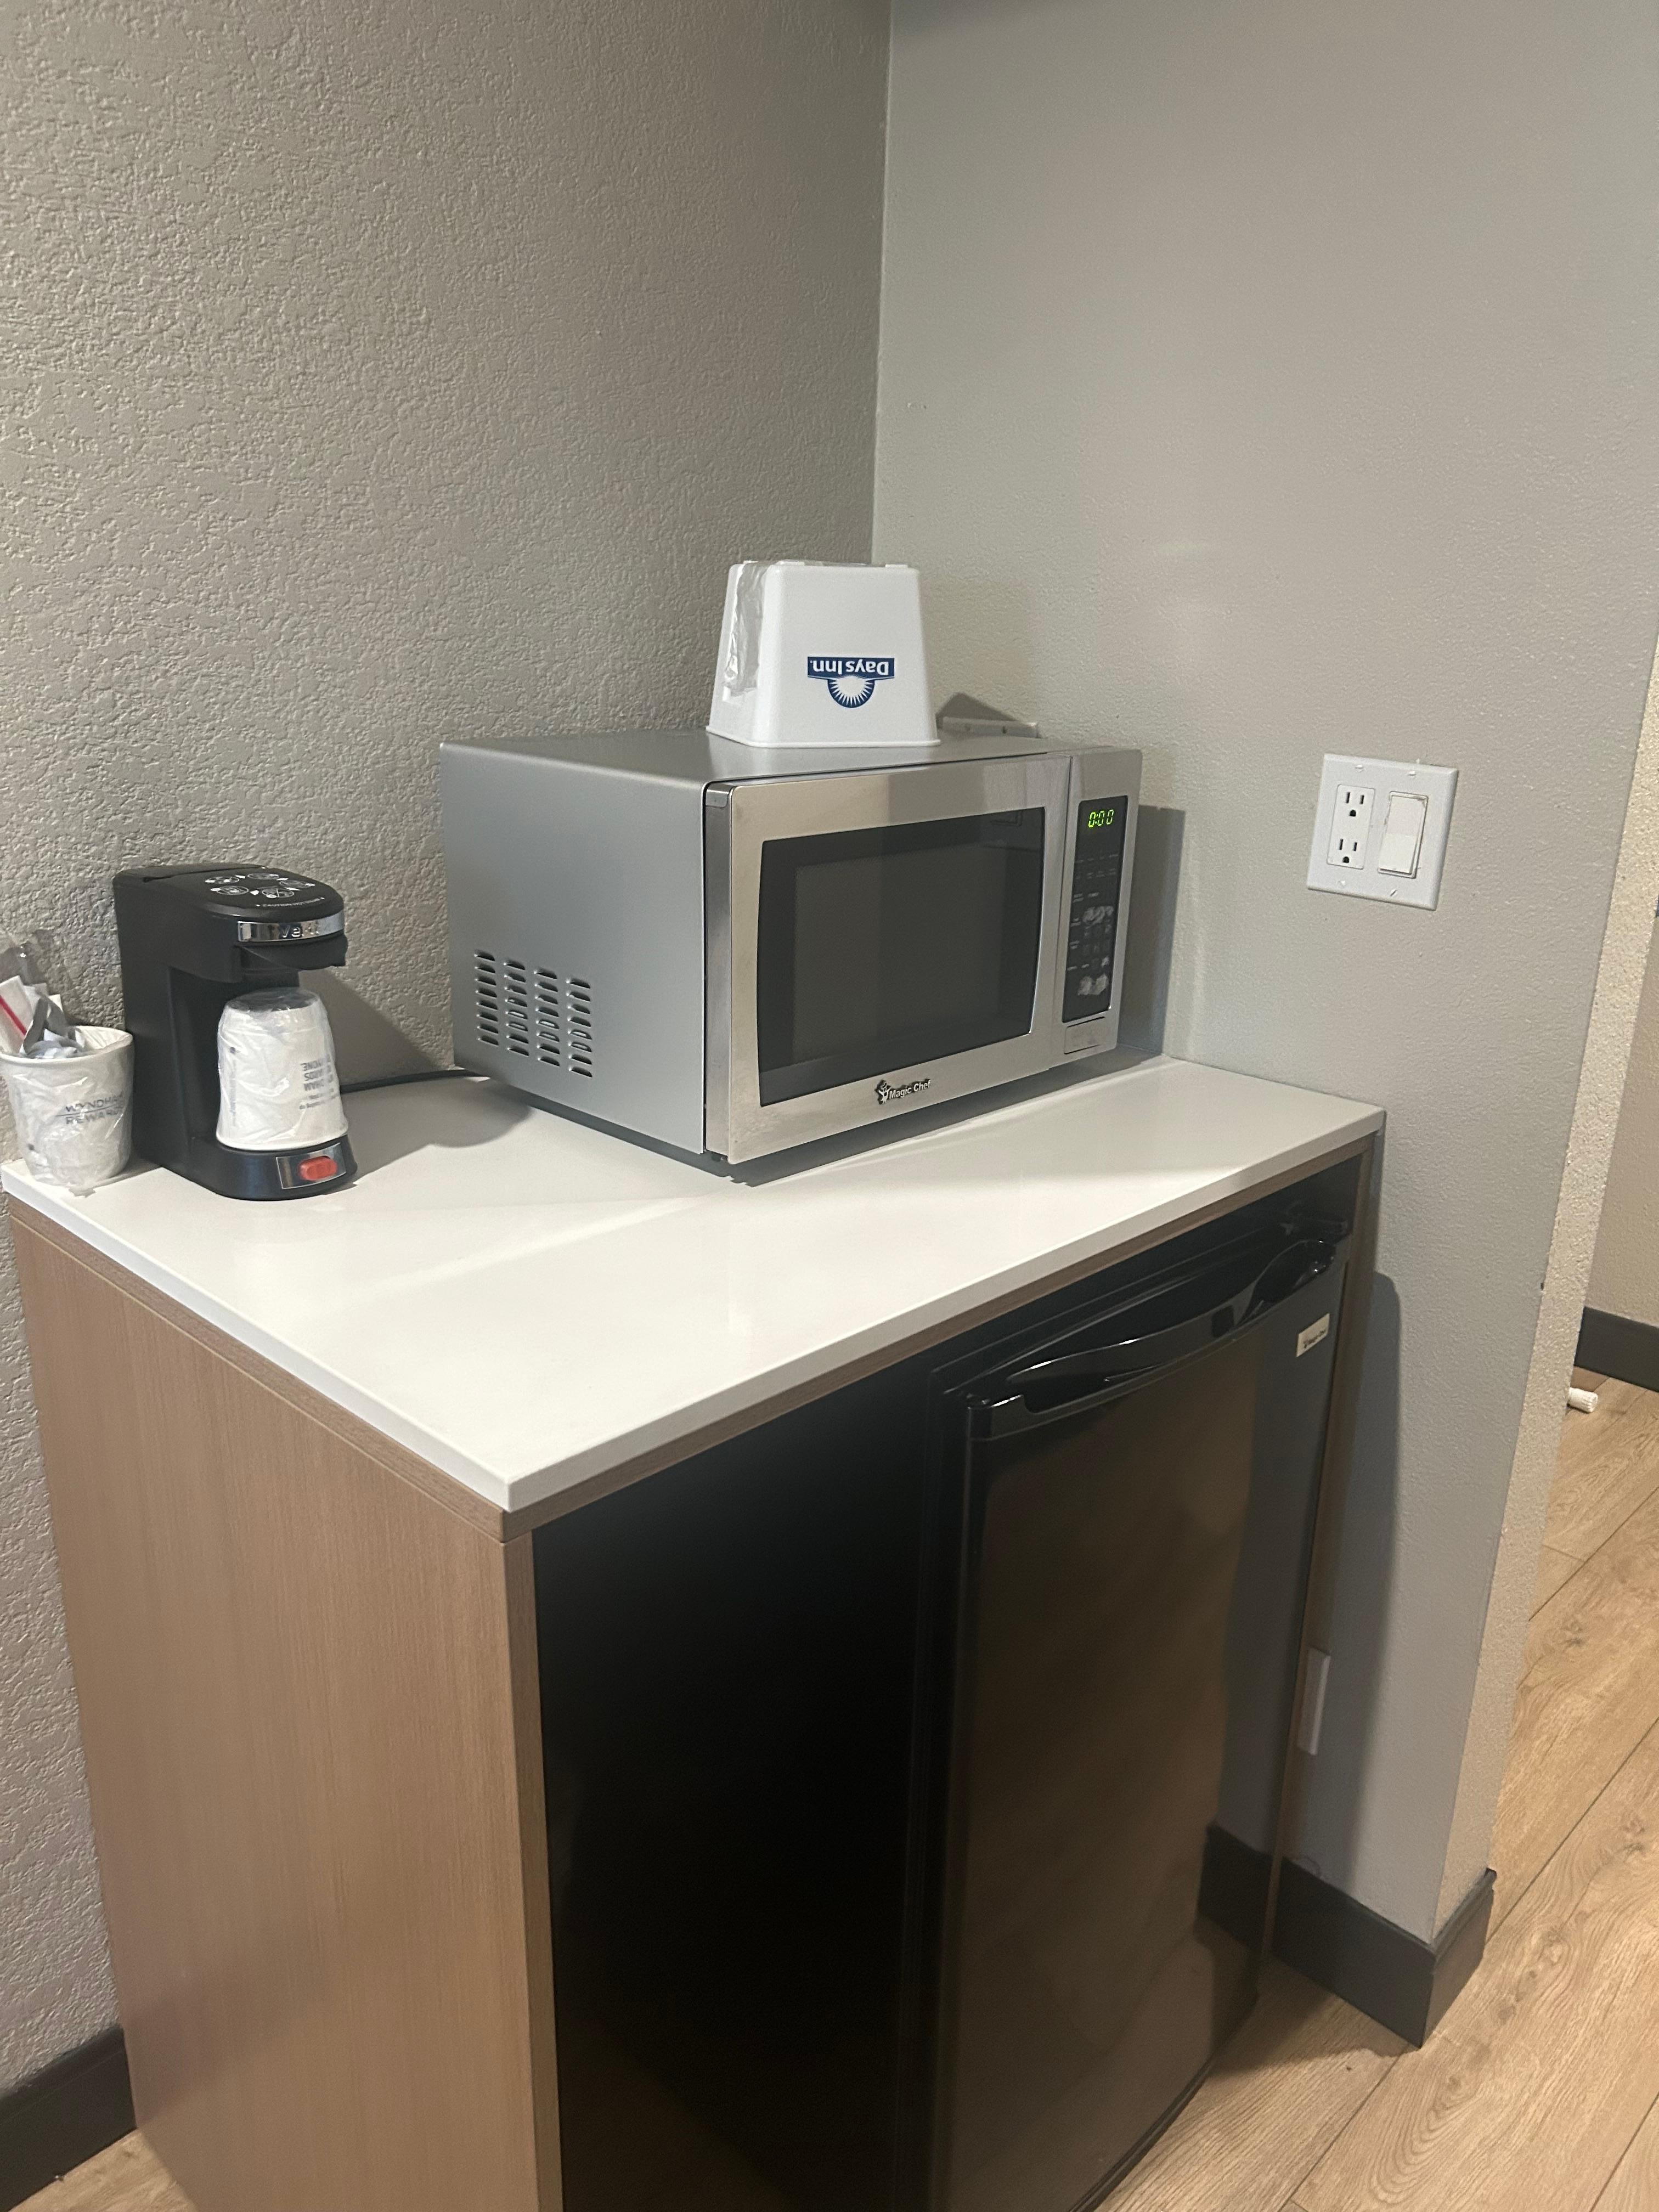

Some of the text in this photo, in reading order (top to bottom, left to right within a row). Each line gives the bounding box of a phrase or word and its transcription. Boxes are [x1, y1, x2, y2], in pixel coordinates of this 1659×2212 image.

[812, 659, 889, 676] Days Inn
[1088, 809, 1114, 828] 0:00
[889, 1079, 931, 1099] Magic Chef
